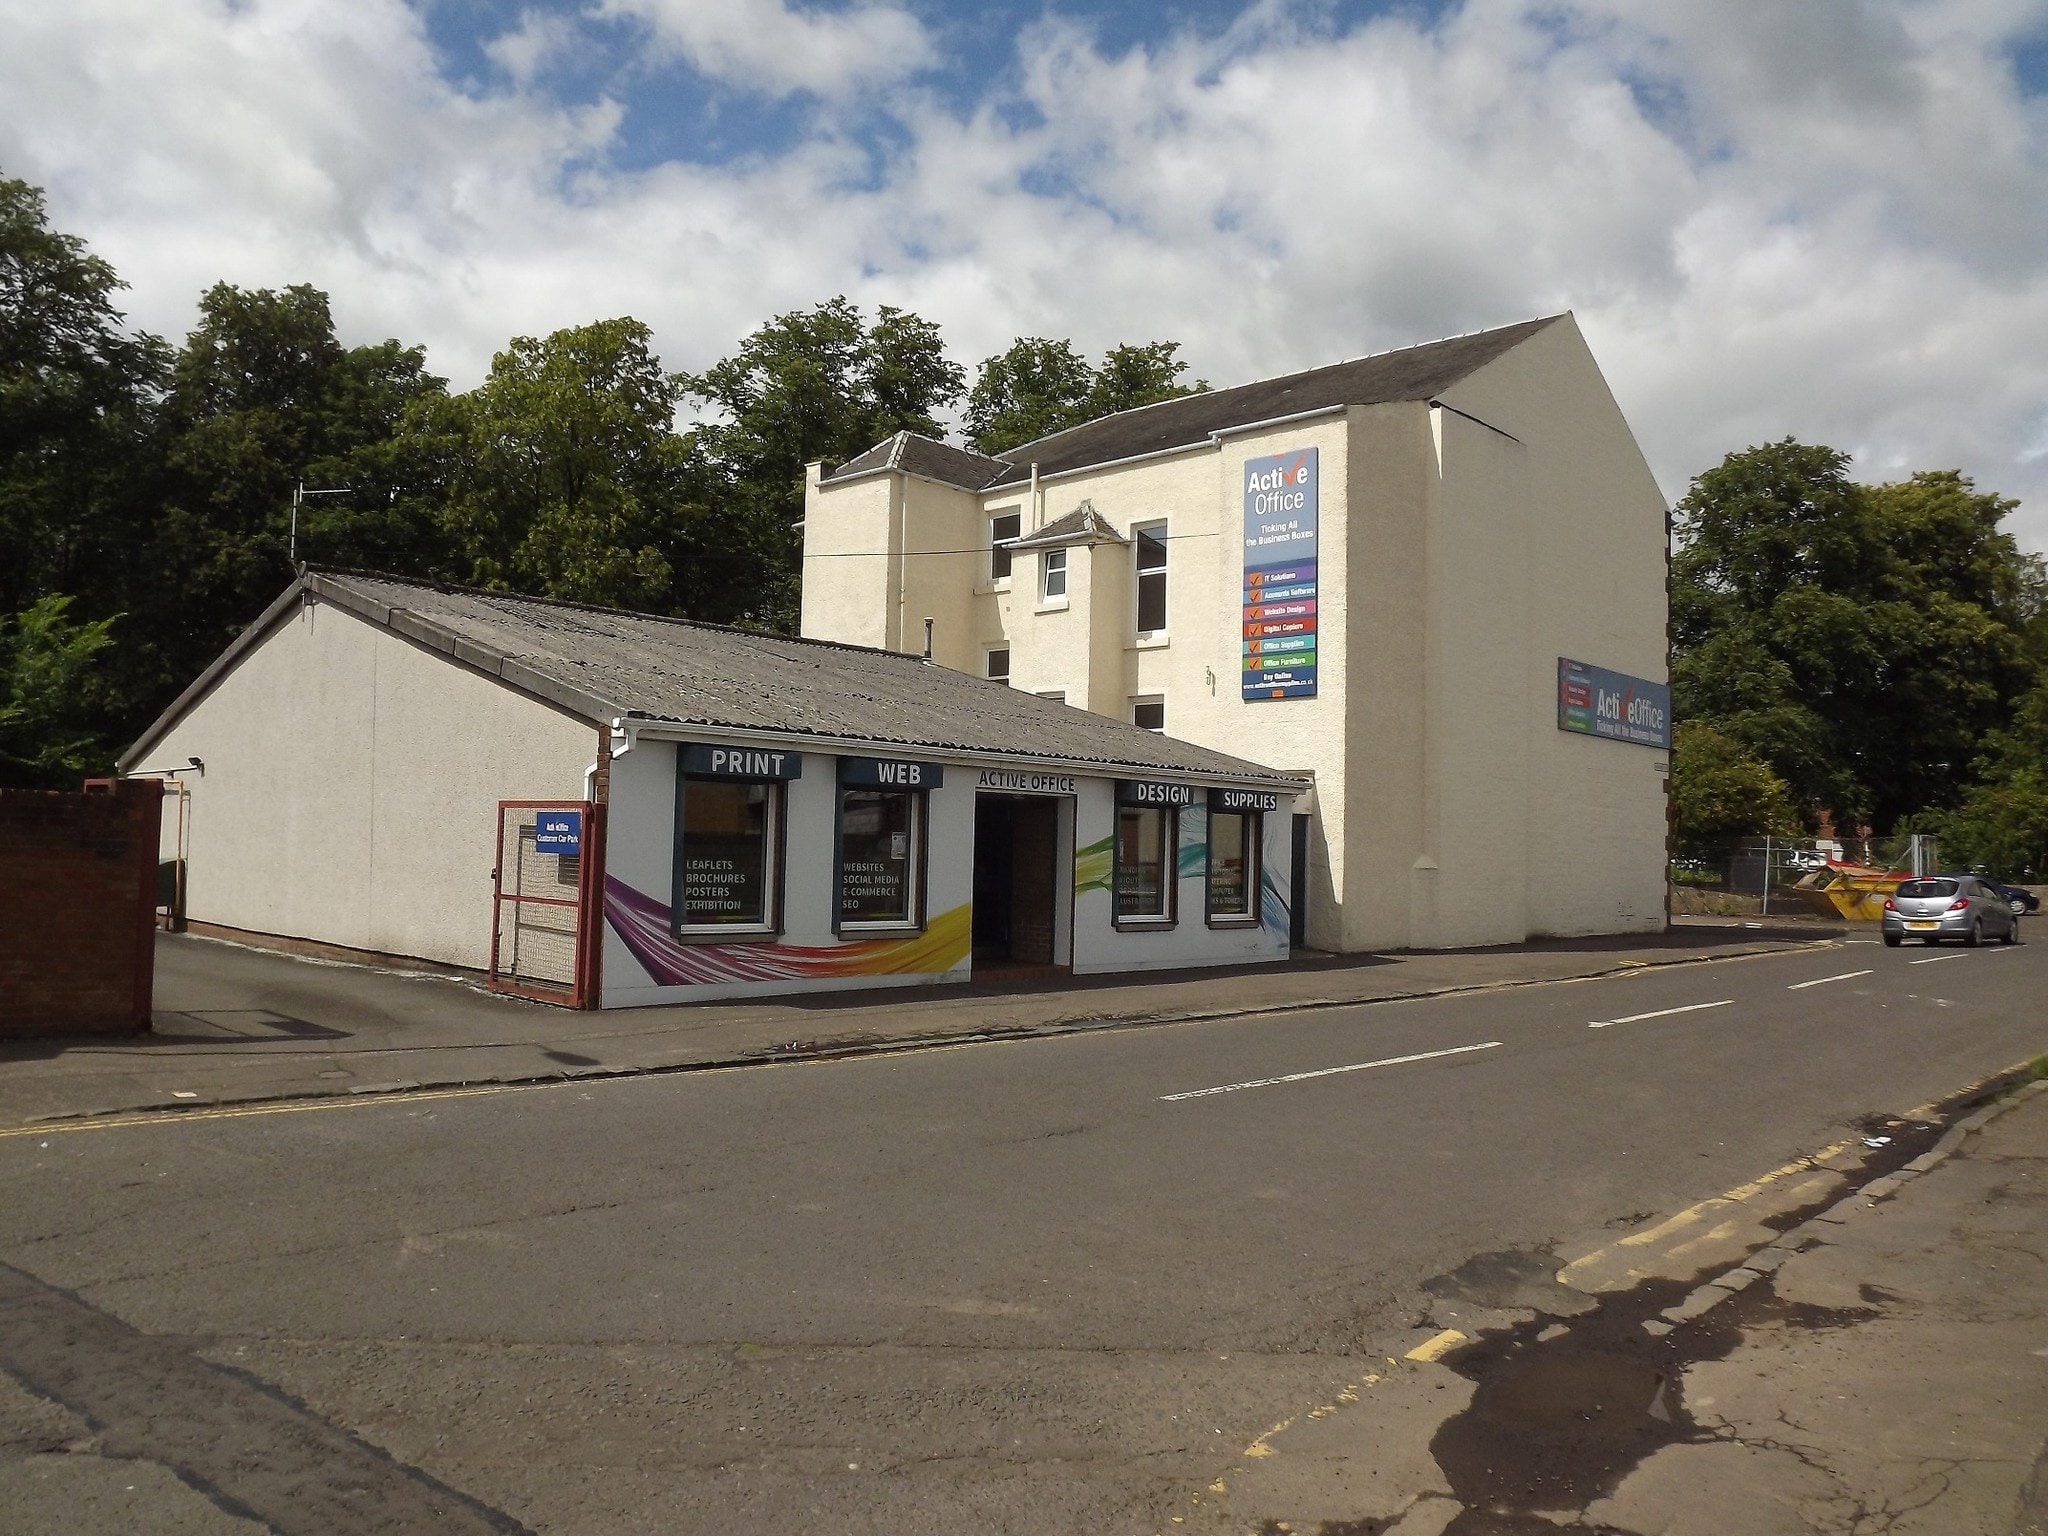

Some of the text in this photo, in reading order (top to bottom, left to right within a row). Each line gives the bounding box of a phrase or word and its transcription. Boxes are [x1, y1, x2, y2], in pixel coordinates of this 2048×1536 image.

[1255, 491, 1304, 515] Office
[1261, 520, 1298, 534] Ticking All
[1246, 530, 1314, 547] the Business Boxes
[1270, 572, 1296, 581] Solutions
[1264, 605, 1306, 616] Website Design
[1263, 625, 1282, 634] Digital
[1263, 640, 1305, 650] Office Supplies
[1263, 657, 1306, 667] Office Furniture
[711, 749, 785, 776] PRINT
[877, 762, 921, 785] WEB
[979, 770, 1075, 792] ACTIVE OFFICE
[1137, 783, 1190, 803] DESIGN
[1224, 791, 1276, 810] SUPPLIES
[558, 834, 567, 843] Car
[567, 834, 579, 843] Park
[686, 860, 733, 870] LEAFLETS
[843, 862, 885, 872] WEBSITES
[686, 873, 746, 883] BROCHURES
[843, 875, 900, 885] SOCIAL MEDIA
[685, 887, 730, 897] POSTERS
[842, 887, 896, 896] E-COMMERCE
[685, 900, 741, 910] EXHIBITION
[842, 900, 859, 909] SEO
